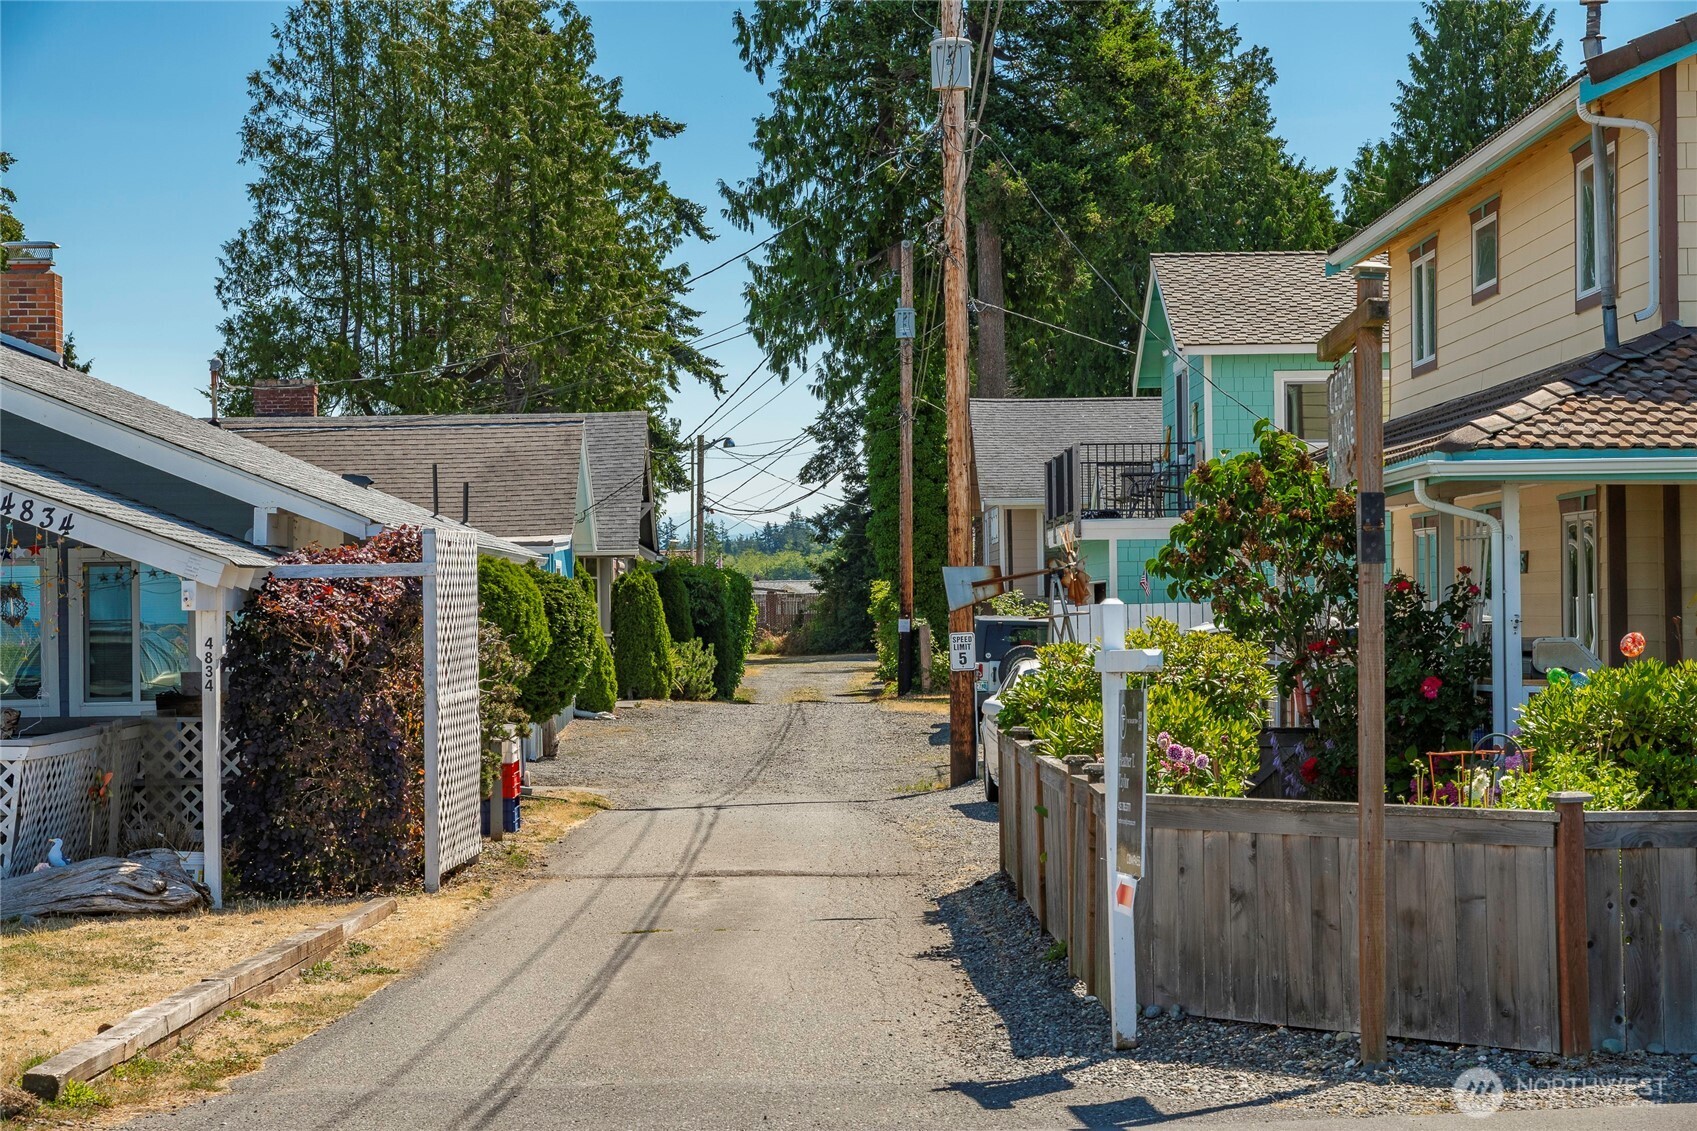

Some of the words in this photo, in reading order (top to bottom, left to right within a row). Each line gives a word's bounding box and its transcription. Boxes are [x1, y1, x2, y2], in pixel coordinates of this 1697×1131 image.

[1330, 362, 1353, 413] CEDAR
[1331, 409, 1355, 457] LANE
[0, 492, 75, 536] 4834
[205, 637, 213, 691] 4834
[959, 652, 967, 665] 5
